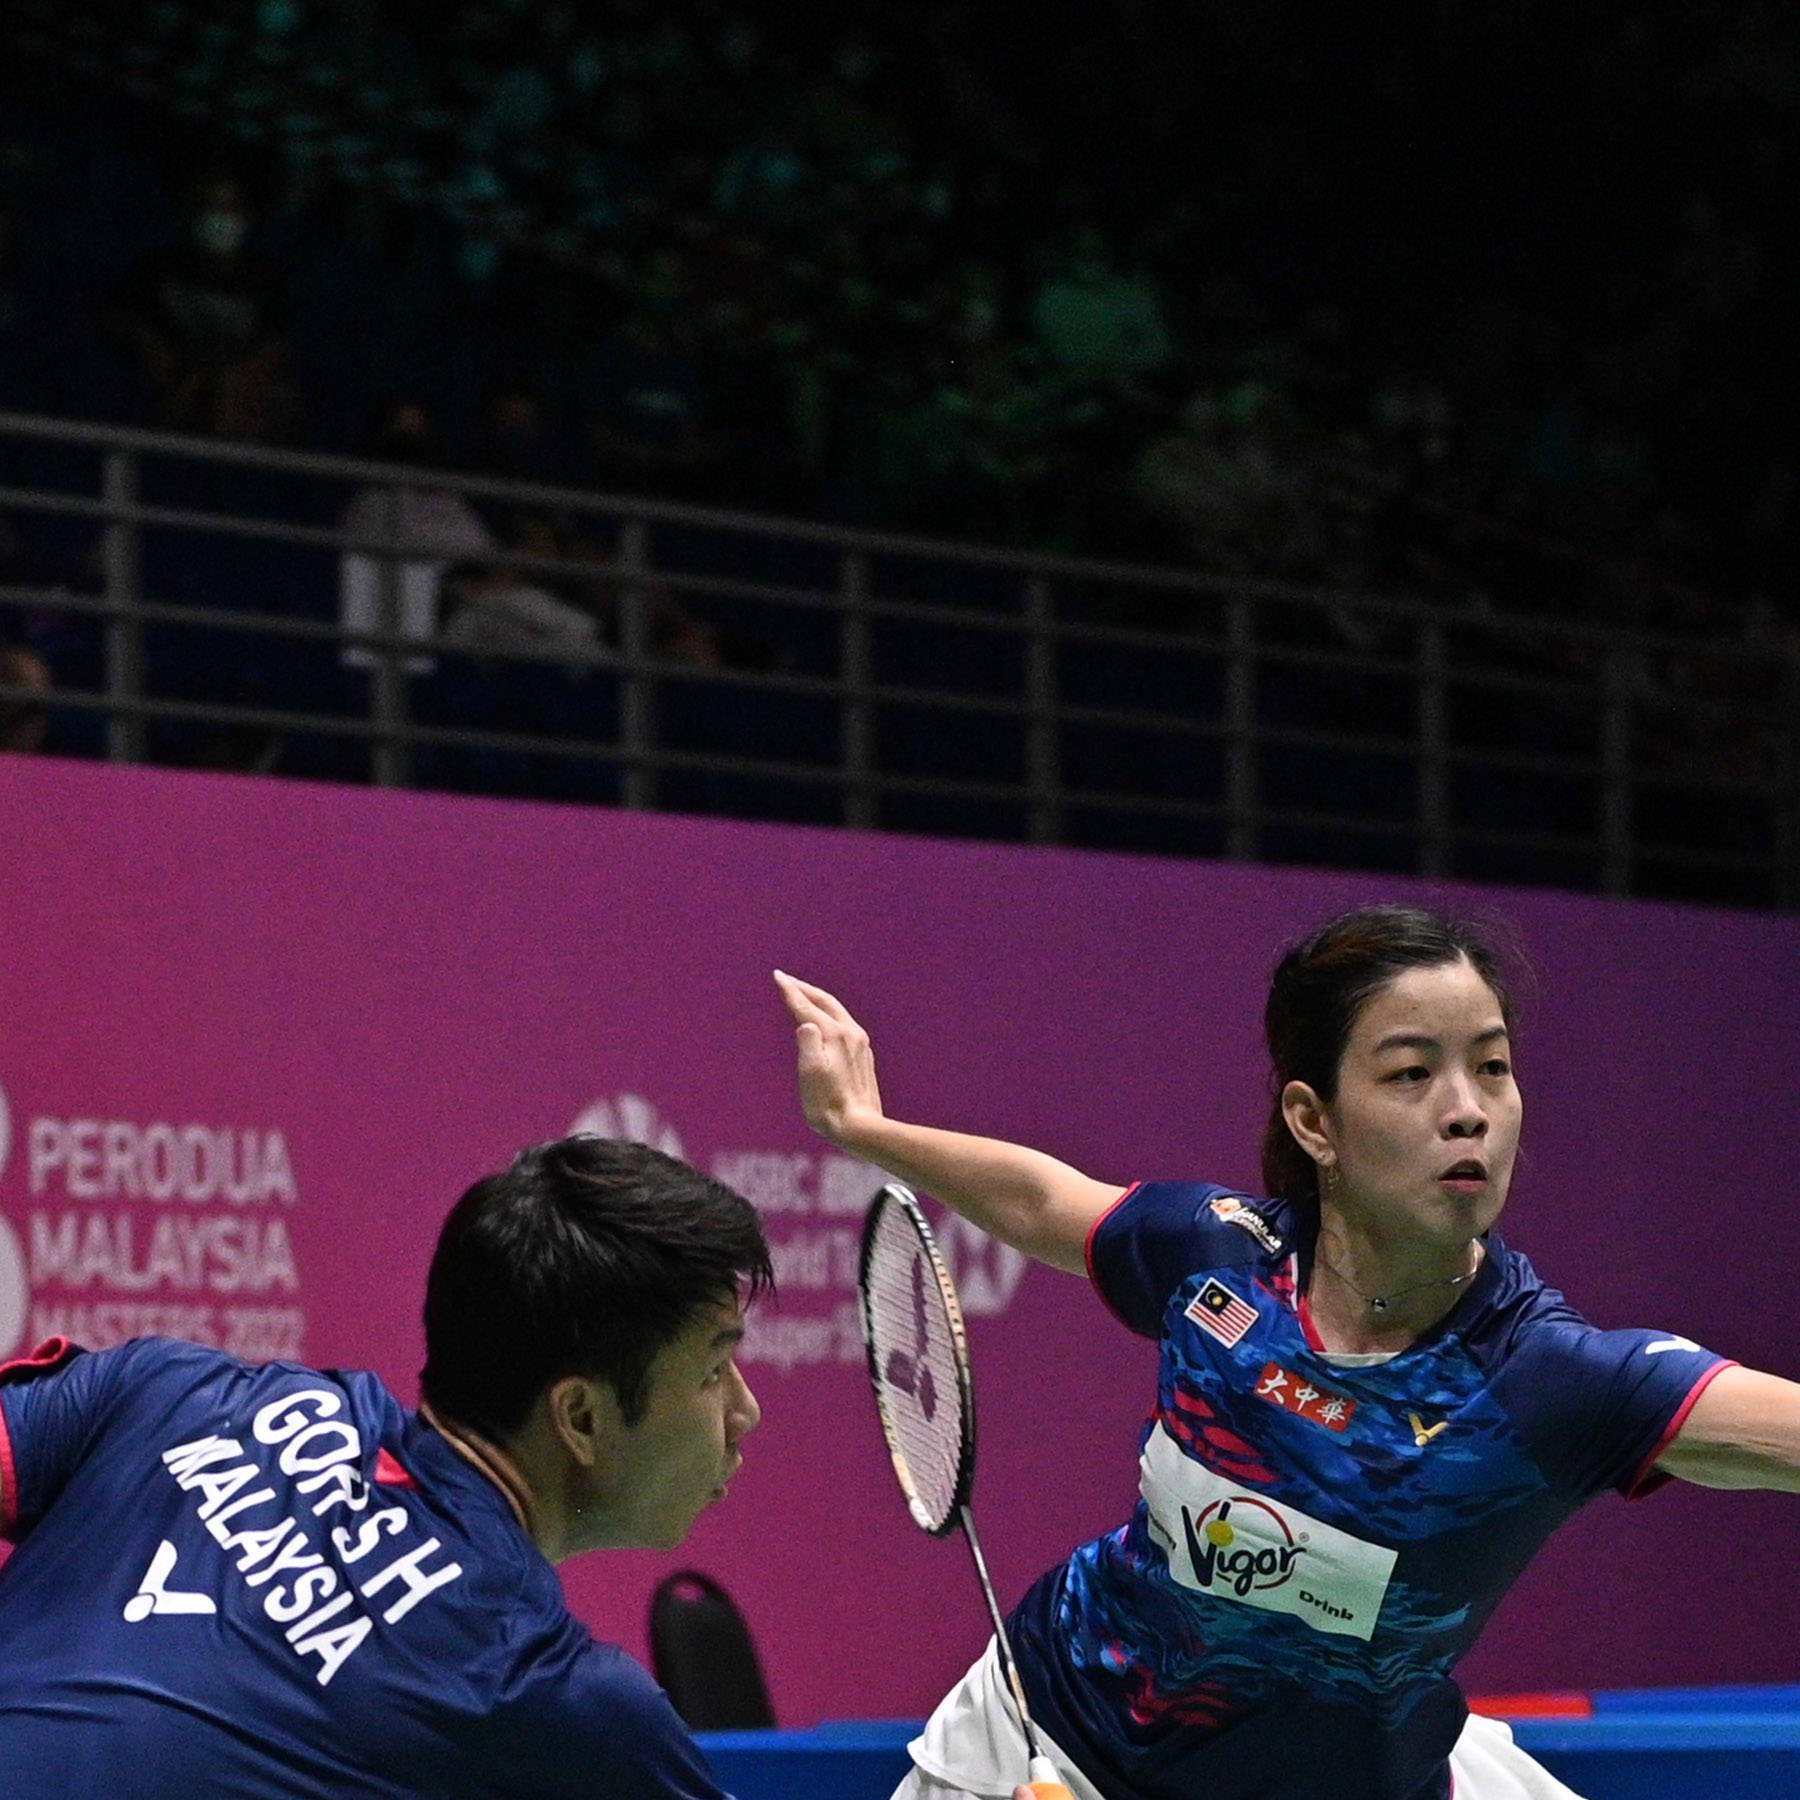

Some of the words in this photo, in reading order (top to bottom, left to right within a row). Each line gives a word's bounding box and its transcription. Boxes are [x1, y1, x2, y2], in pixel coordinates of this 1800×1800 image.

[30, 1119, 298, 1202] PERODUA
[31, 1210, 299, 1293] MALAYSIA
[1257, 1368, 1346, 1424] 大中華
[162, 1434, 374, 1686] MALAYSIA
[331, 1505, 408, 1563] S
[1181, 1500, 1307, 1597] Vigor
[361, 1537, 463, 1625] H
[1299, 1588, 1355, 1622] Drink
